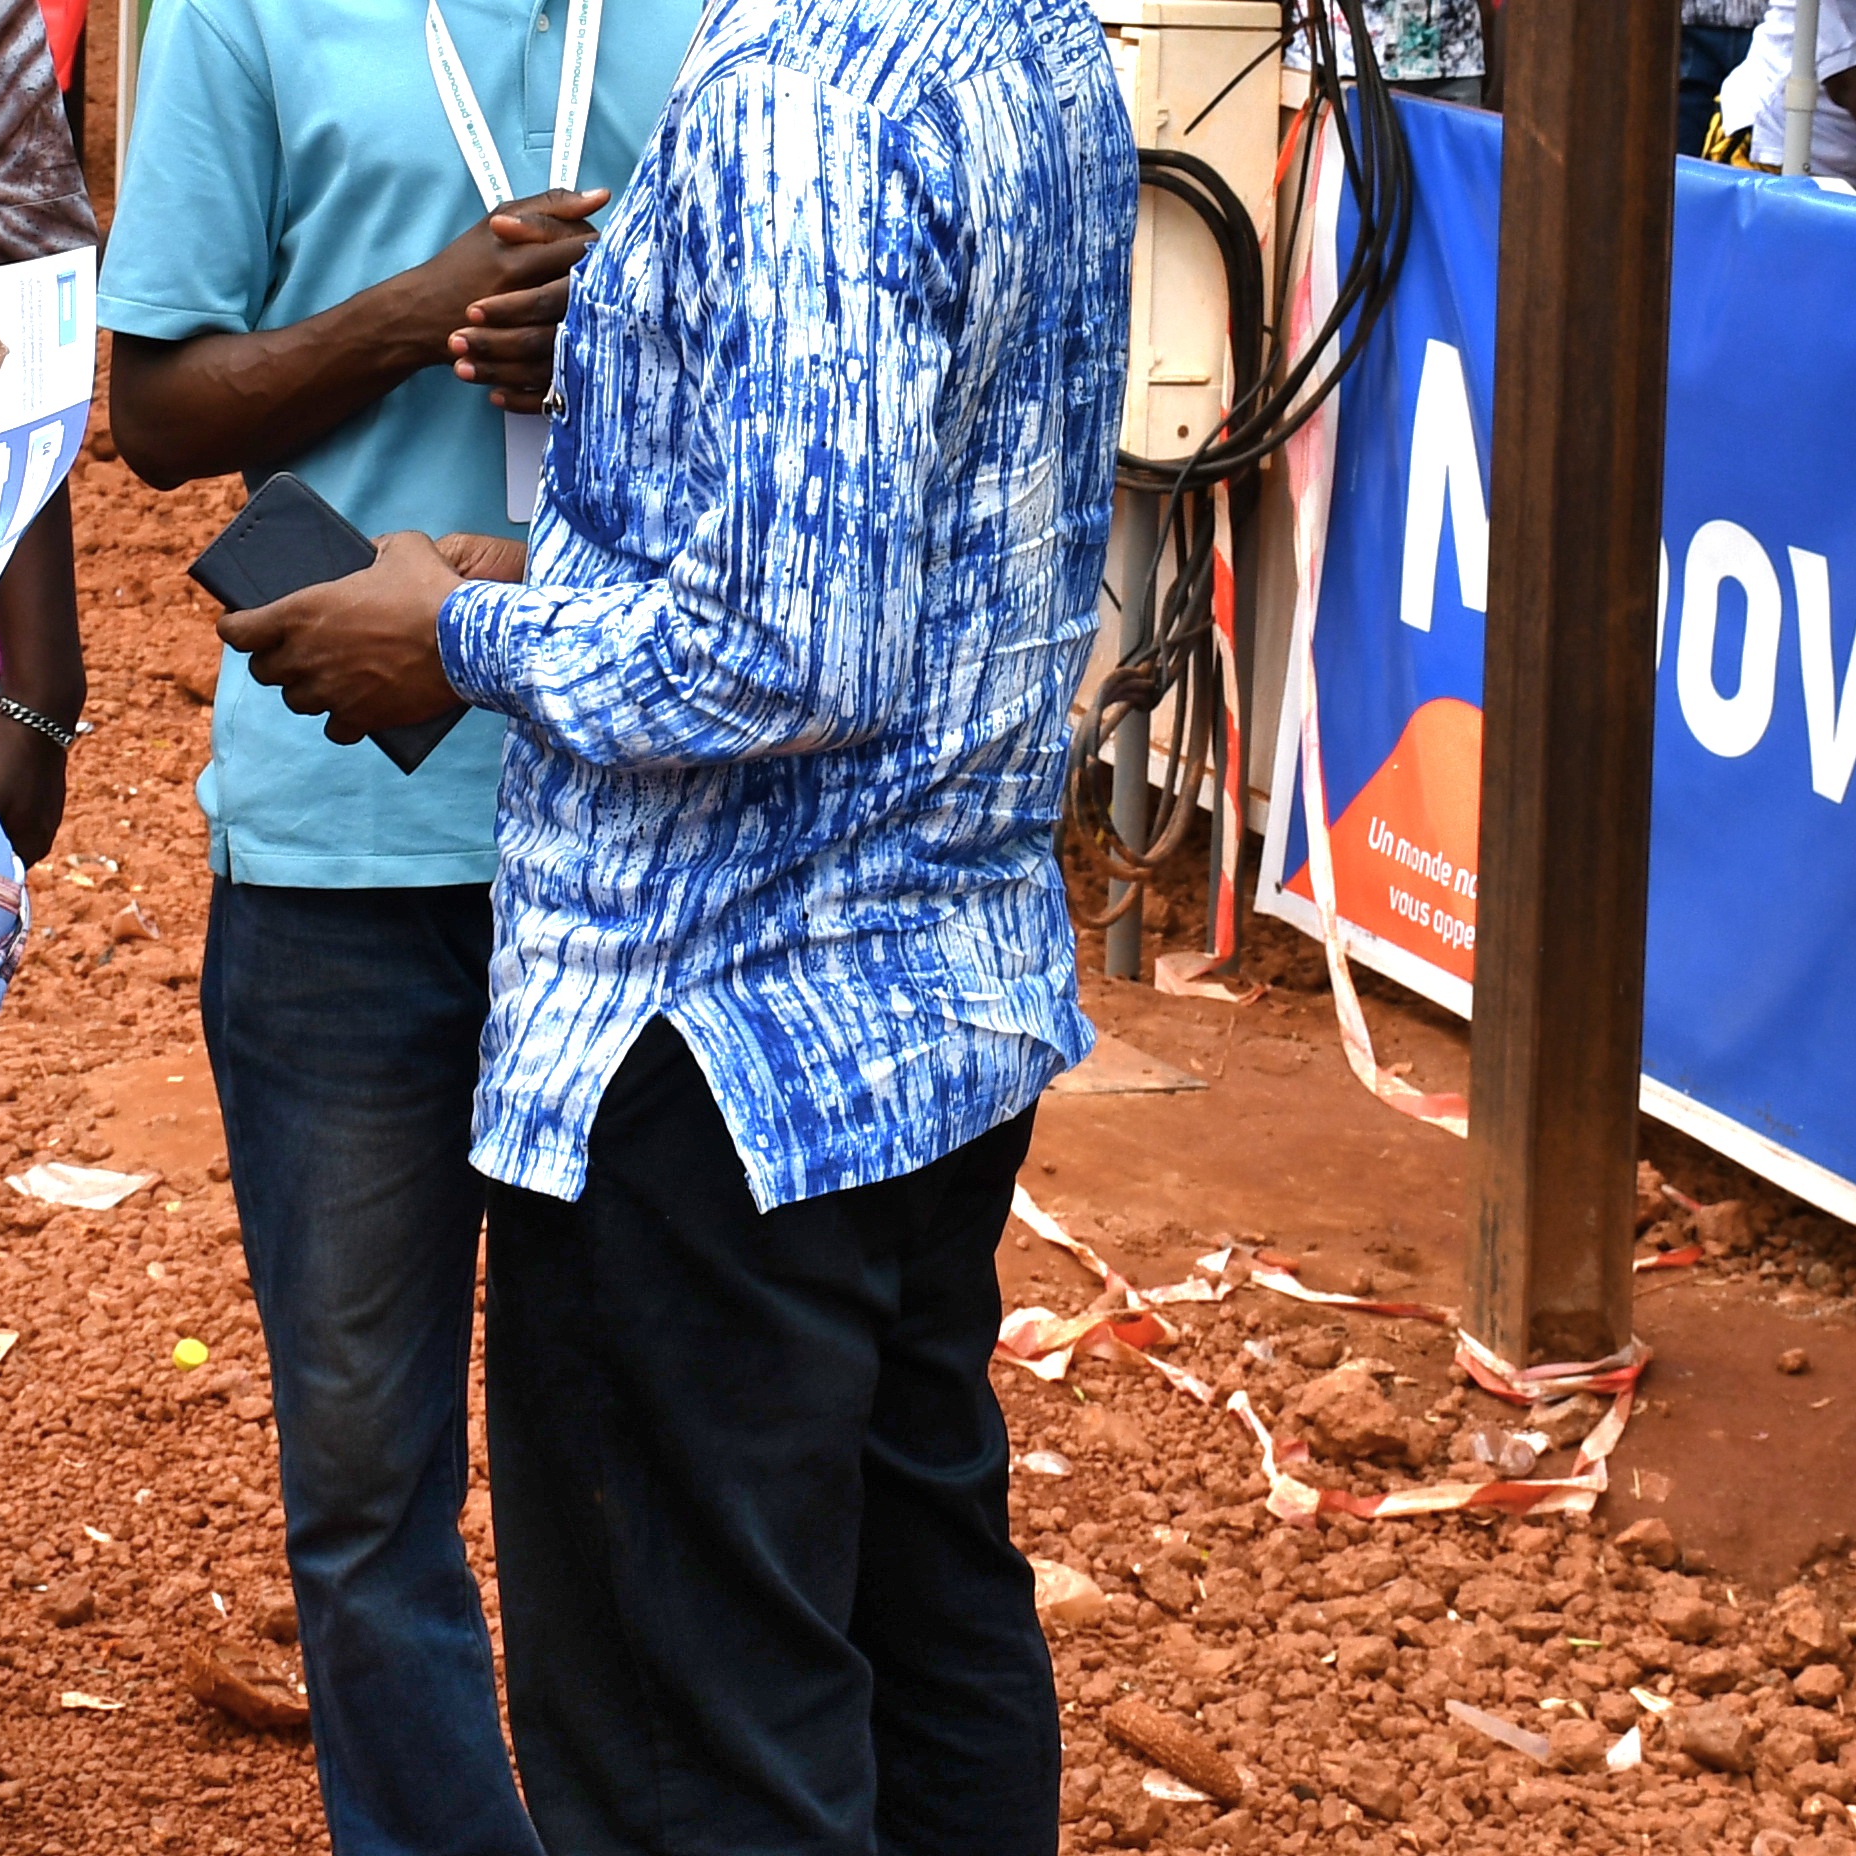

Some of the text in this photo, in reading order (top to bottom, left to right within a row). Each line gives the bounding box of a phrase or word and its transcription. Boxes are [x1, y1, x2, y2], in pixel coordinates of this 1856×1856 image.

[576, 27, 587, 39] la
[570, 40, 585, 105] promouvoir
[441, 59, 472, 120] promouvoir
[562, 150, 570, 162] la
[482, 160, 492, 172] la
[559, 164, 569, 182] par
[488, 173, 502, 192] par
[41, 440, 53, 457] 04
[1368, 815, 1394, 857] Un
[1395, 837, 1452, 887] monde
[1389, 885, 1431, 928] vous
